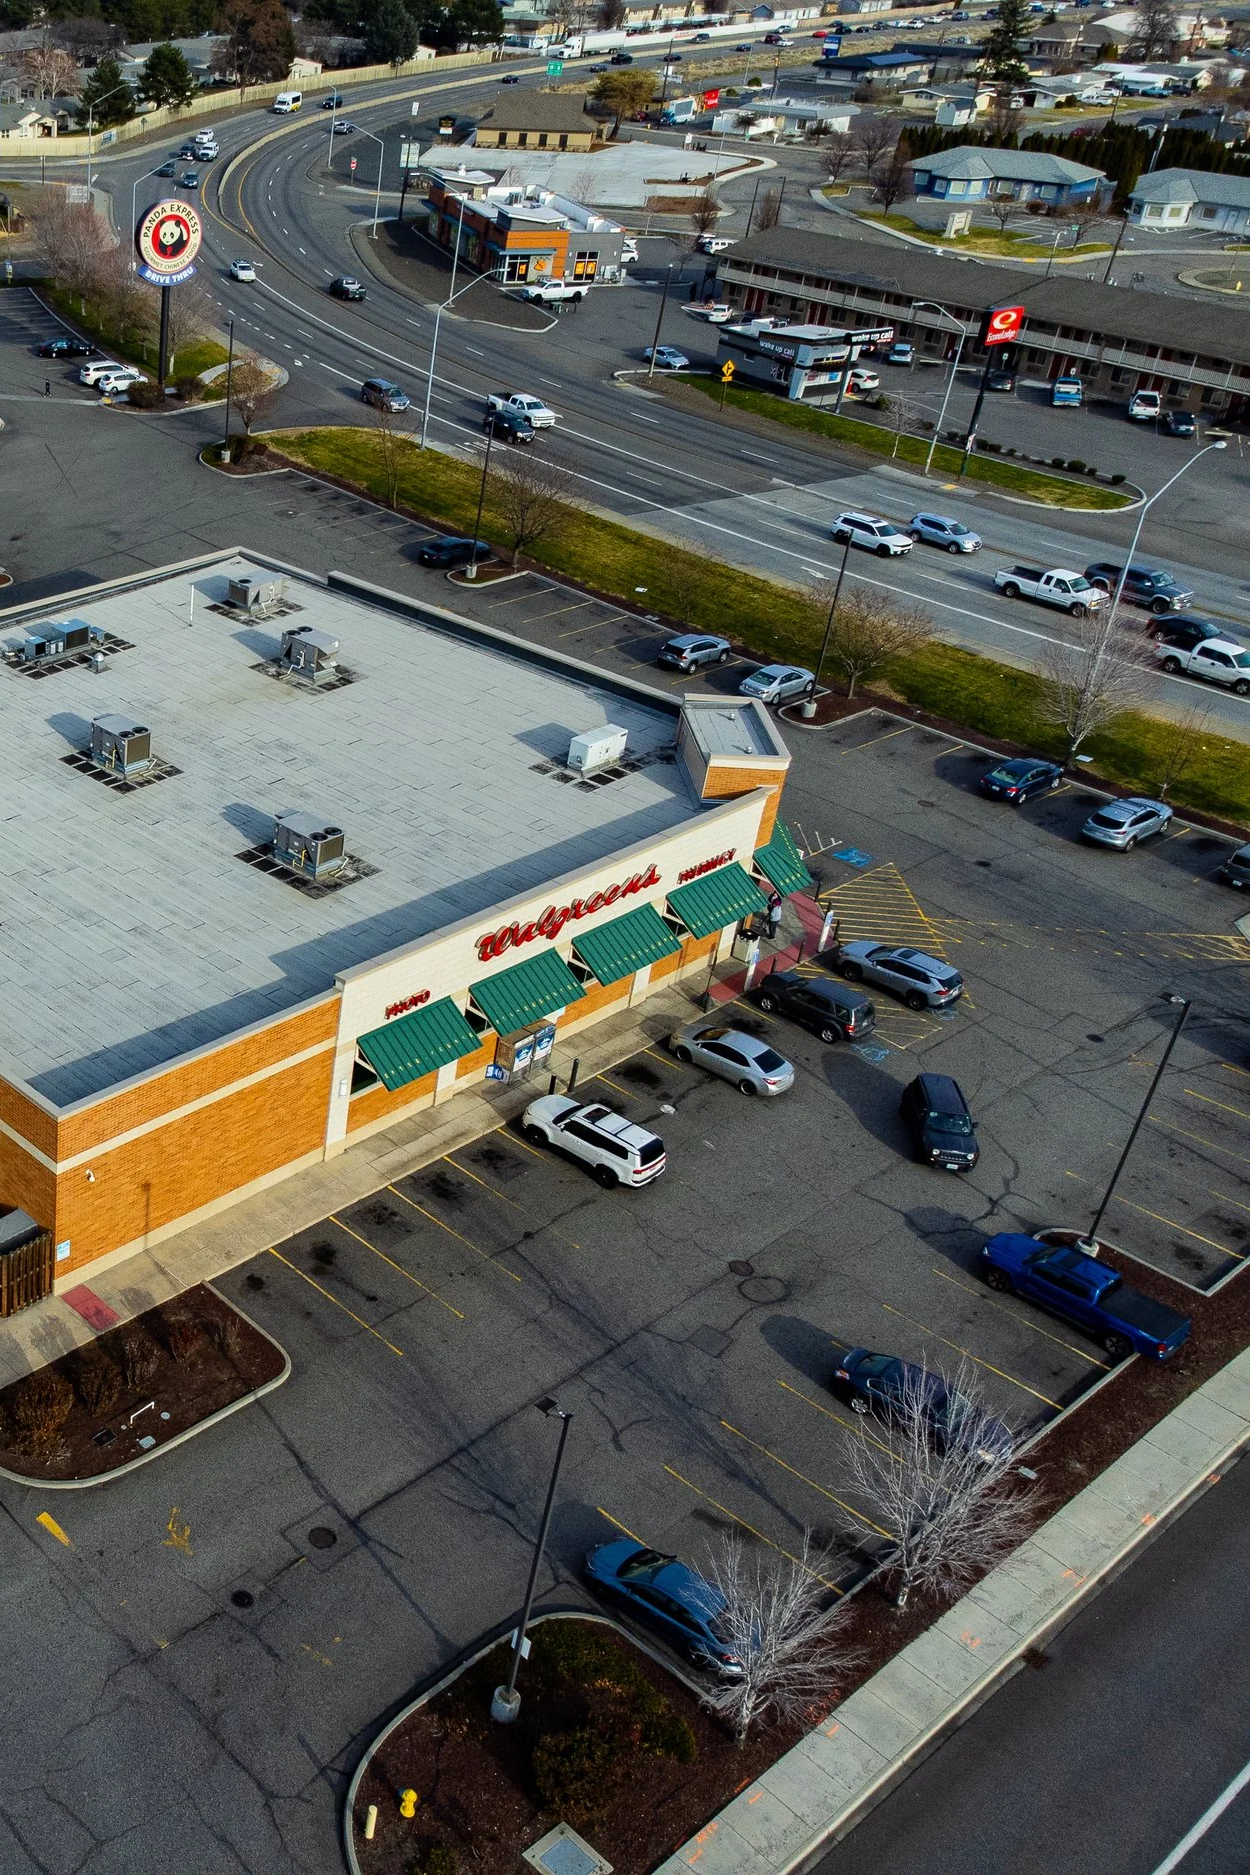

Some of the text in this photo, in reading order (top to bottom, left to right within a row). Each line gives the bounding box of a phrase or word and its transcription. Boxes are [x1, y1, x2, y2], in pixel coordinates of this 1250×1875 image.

[144, 204, 199, 238] PANDA EXPRESS
[144, 244, 197, 269] GOURMET CHINESE FOOD
[145, 266, 194, 283] DRIVE THRU
[759, 340, 774, 350] wake
[783, 348, 795, 356] call
[852, 334, 870, 342] wake
[871, 333, 880, 341] up
[881, 330, 894, 339] call
[474, 863, 662, 962] Walgreens
[384, 989, 430, 1020] PHOTO
